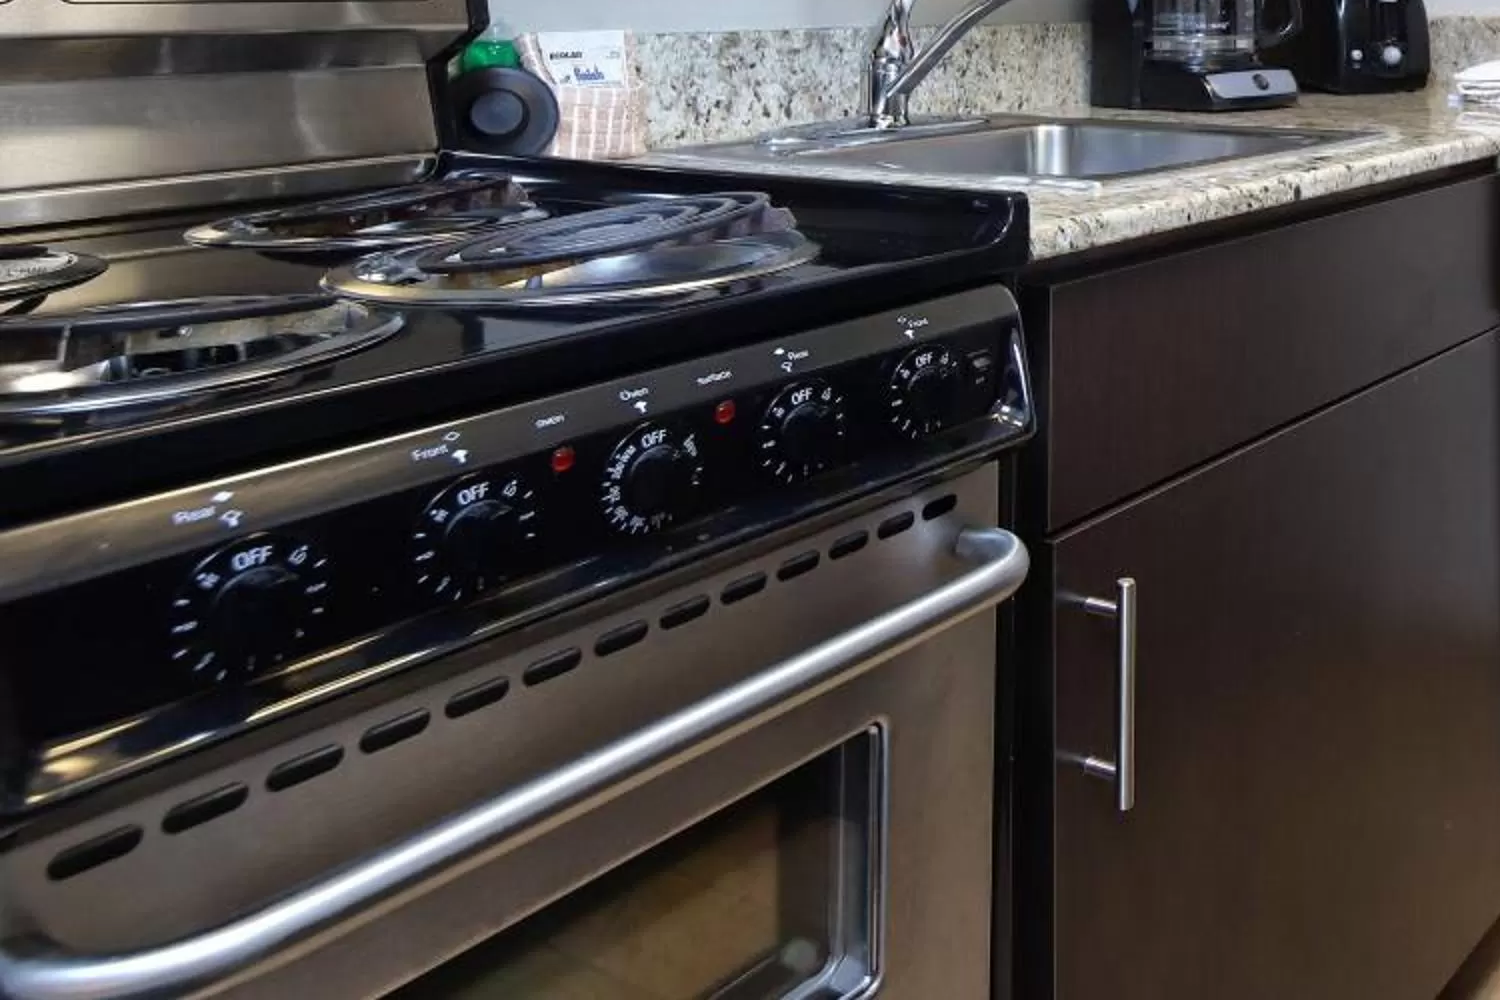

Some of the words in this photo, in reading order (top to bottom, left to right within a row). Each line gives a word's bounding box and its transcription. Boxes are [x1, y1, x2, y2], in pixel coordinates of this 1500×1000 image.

[915, 352, 933, 368] OFF
[791, 388, 813, 405] OFF
[641, 429, 667, 448] OFF
[457, 481, 490, 505] OFF
[231, 545, 273, 571] OFF
